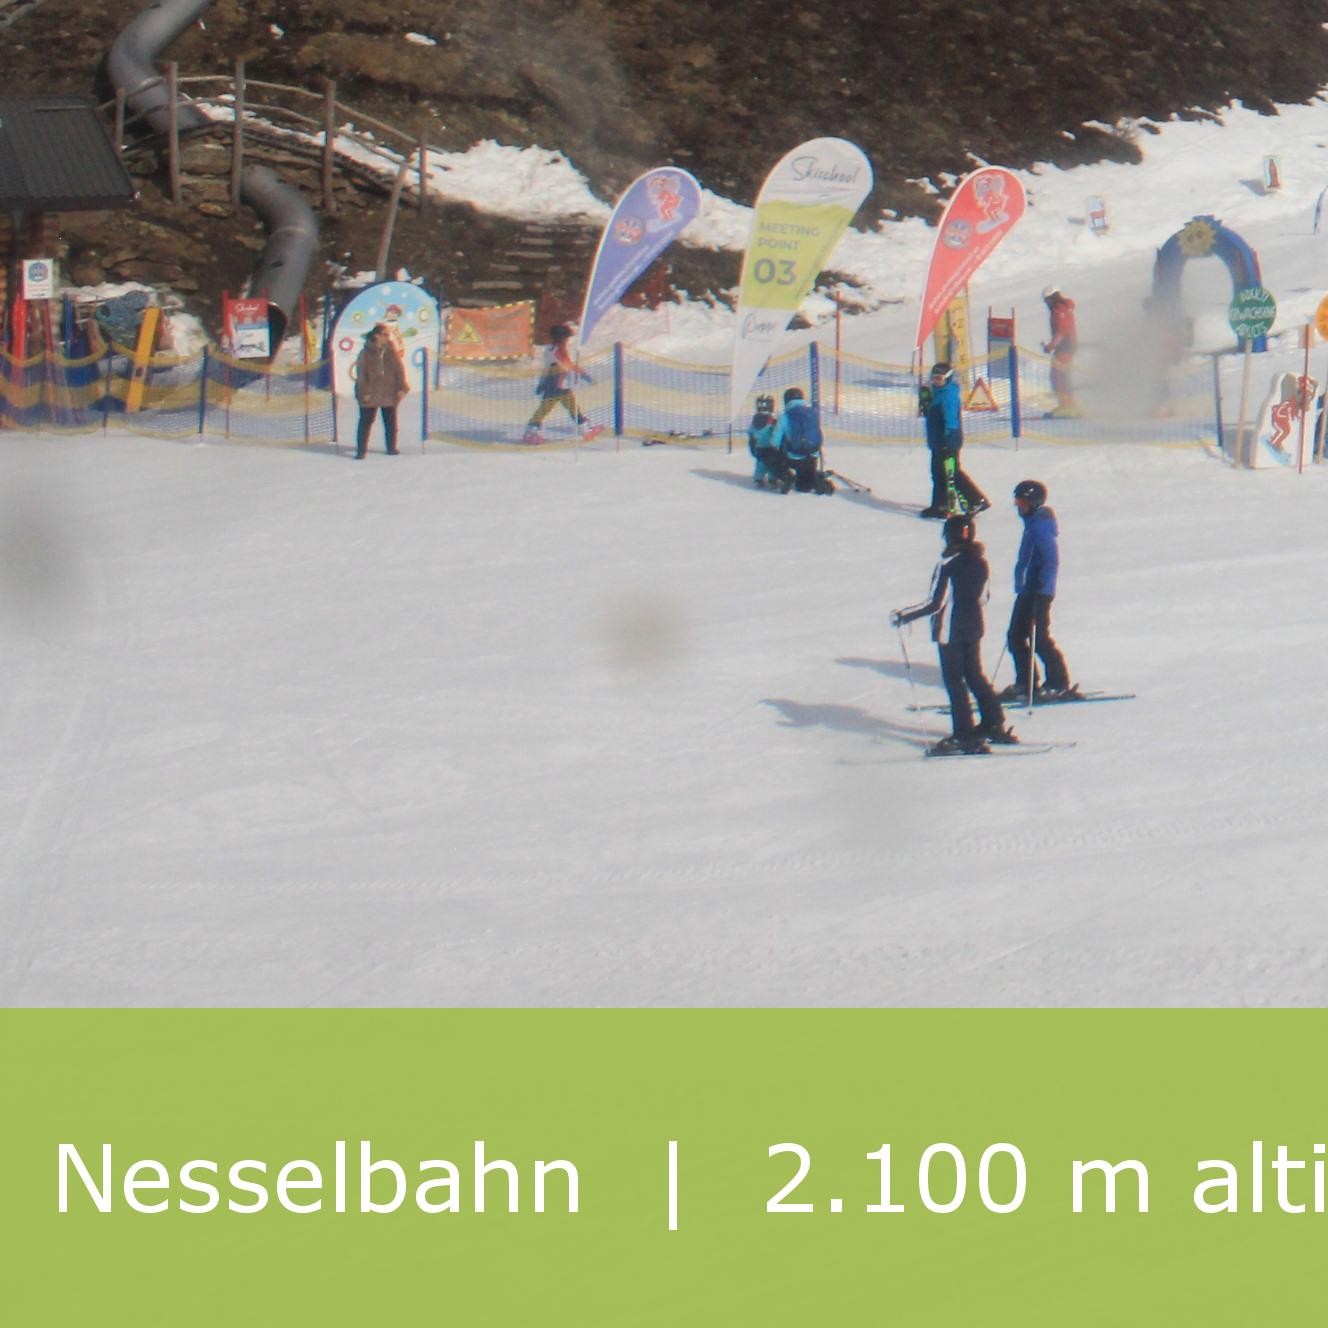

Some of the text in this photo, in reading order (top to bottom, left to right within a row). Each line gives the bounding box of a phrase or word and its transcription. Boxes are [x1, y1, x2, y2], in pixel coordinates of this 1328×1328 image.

[759, 222, 821, 237] MEETING
[757, 237, 801, 250] POINT
[754, 258, 797, 285] 03
